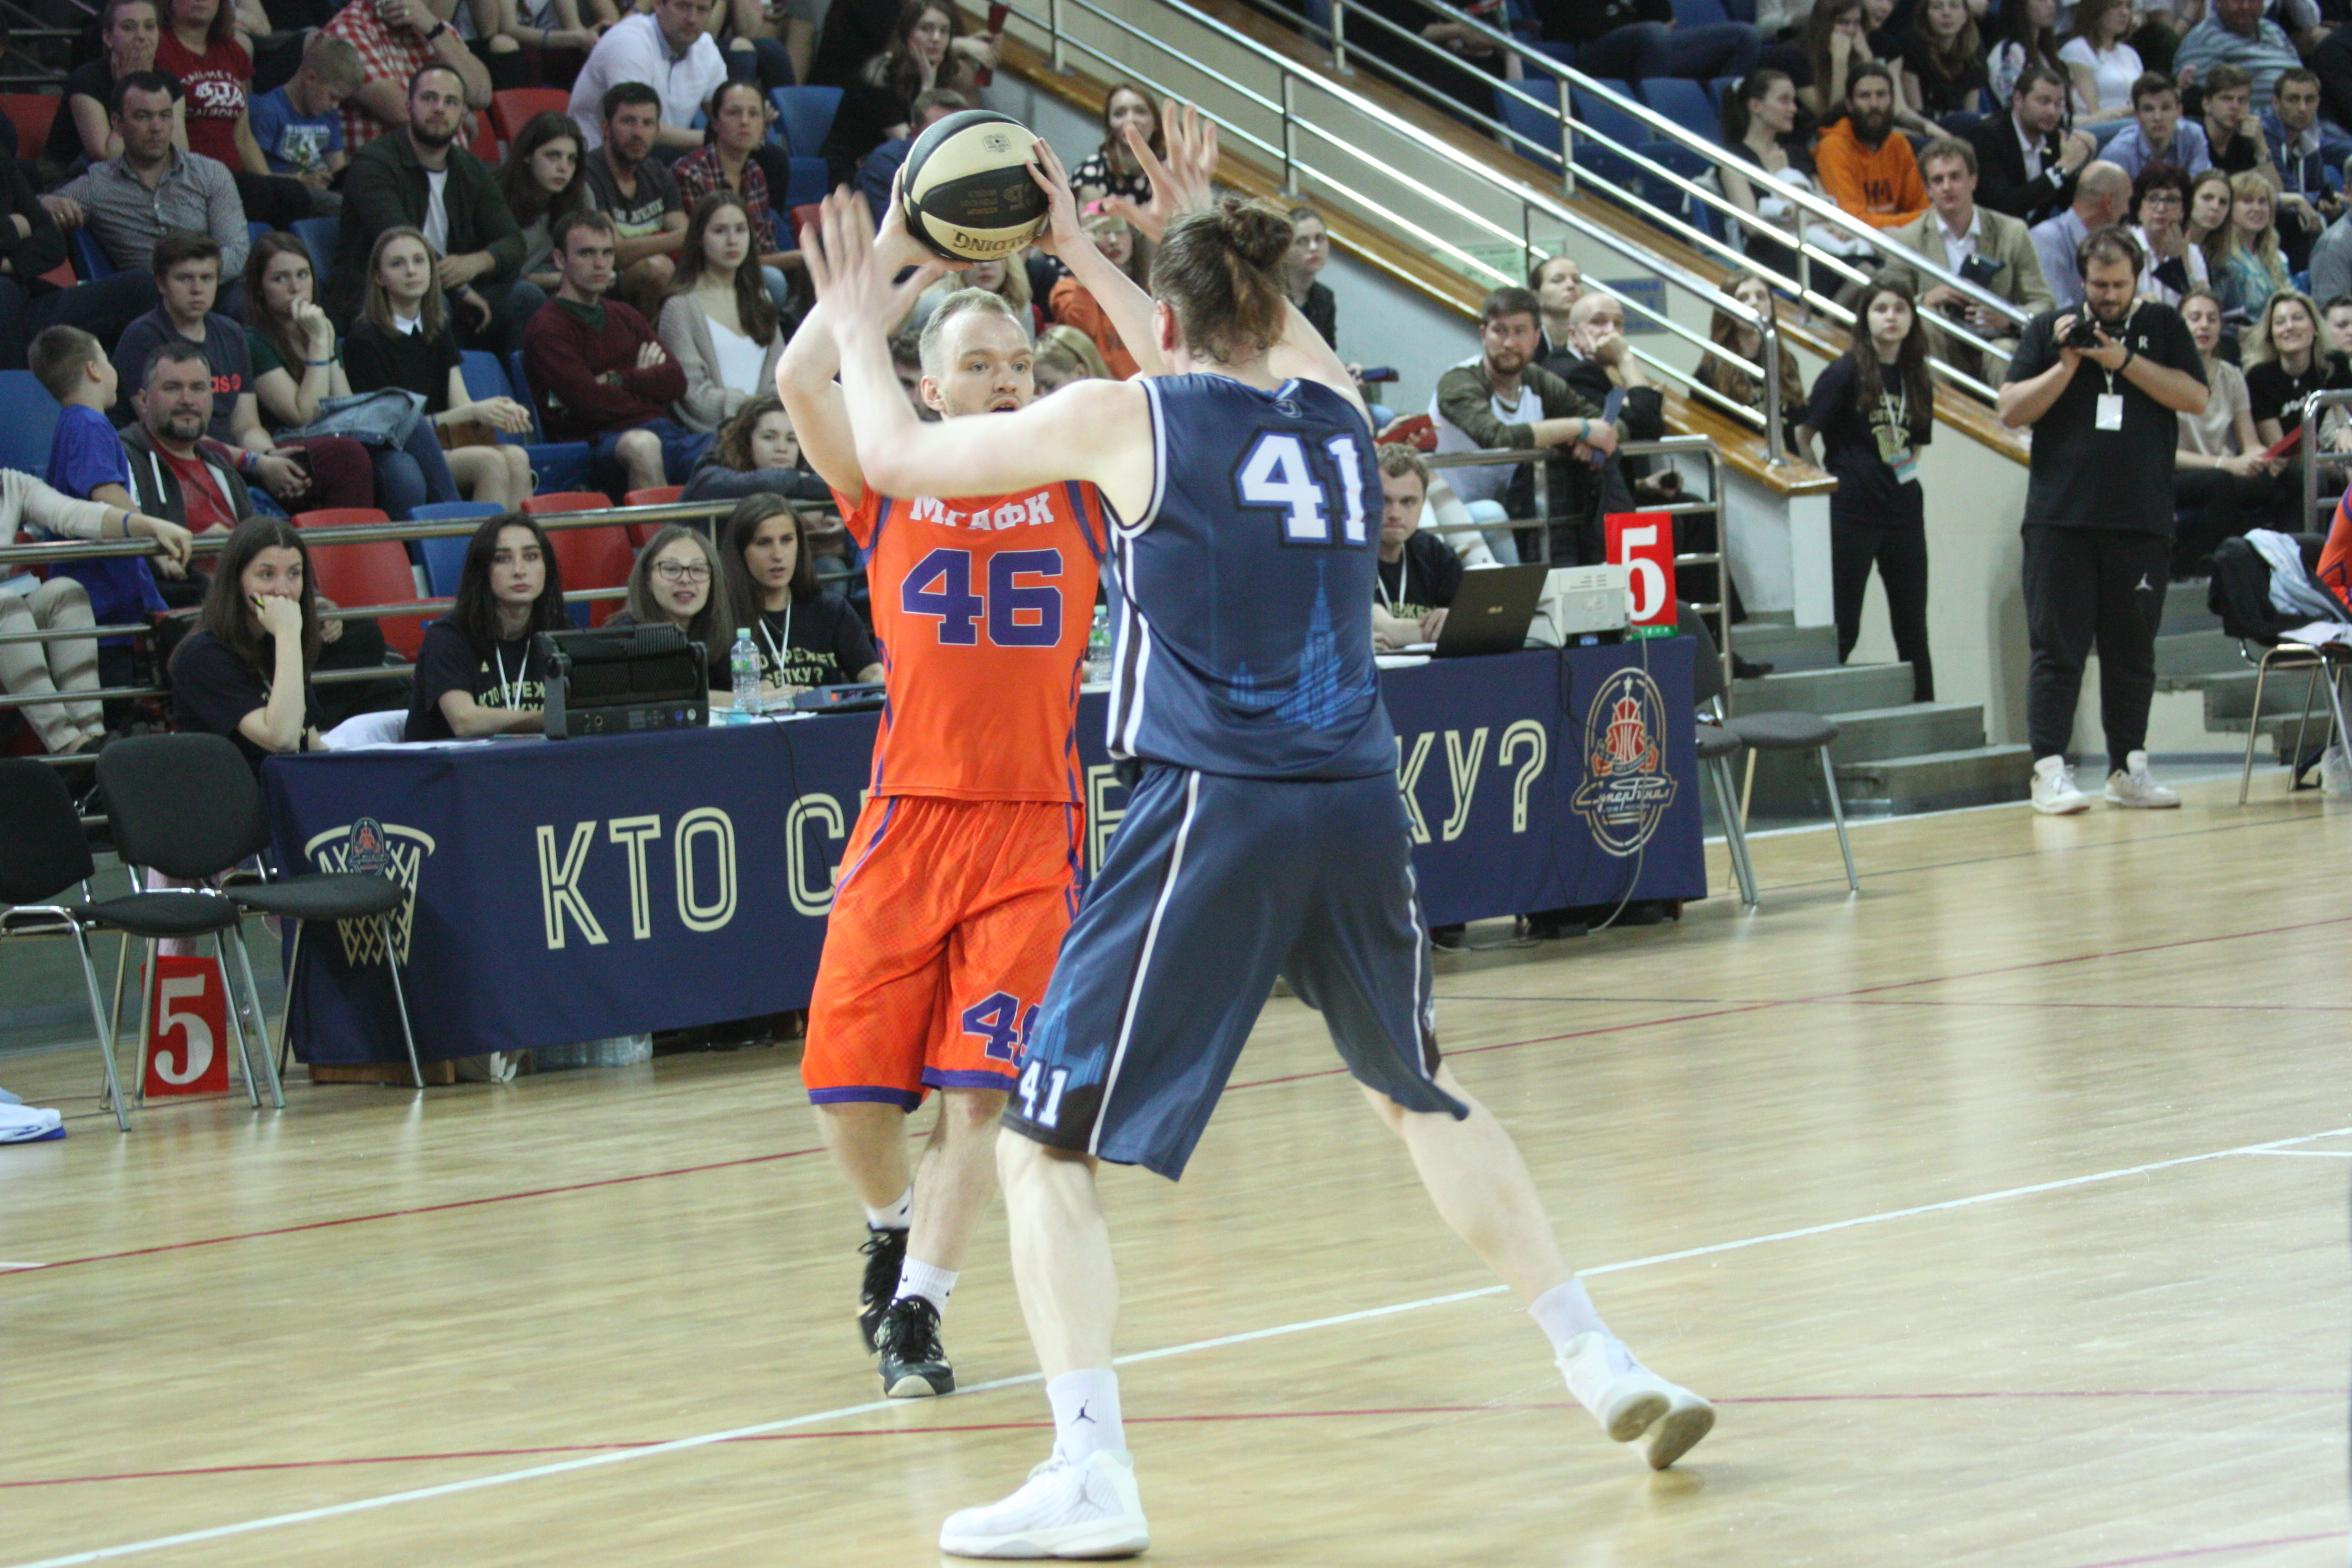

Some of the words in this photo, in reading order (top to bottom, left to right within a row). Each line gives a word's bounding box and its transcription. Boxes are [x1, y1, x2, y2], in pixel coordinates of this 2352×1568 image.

[1234, 431, 1368, 546] 41
[902, 548, 1063, 647] 46
[1622, 525, 1666, 621] 5
[536, 807, 738, 949] КТО
[1395, 719, 1547, 845] КУ?
[155, 974, 213, 1085] 5
[1019, 1060, 1068, 1127] 41
